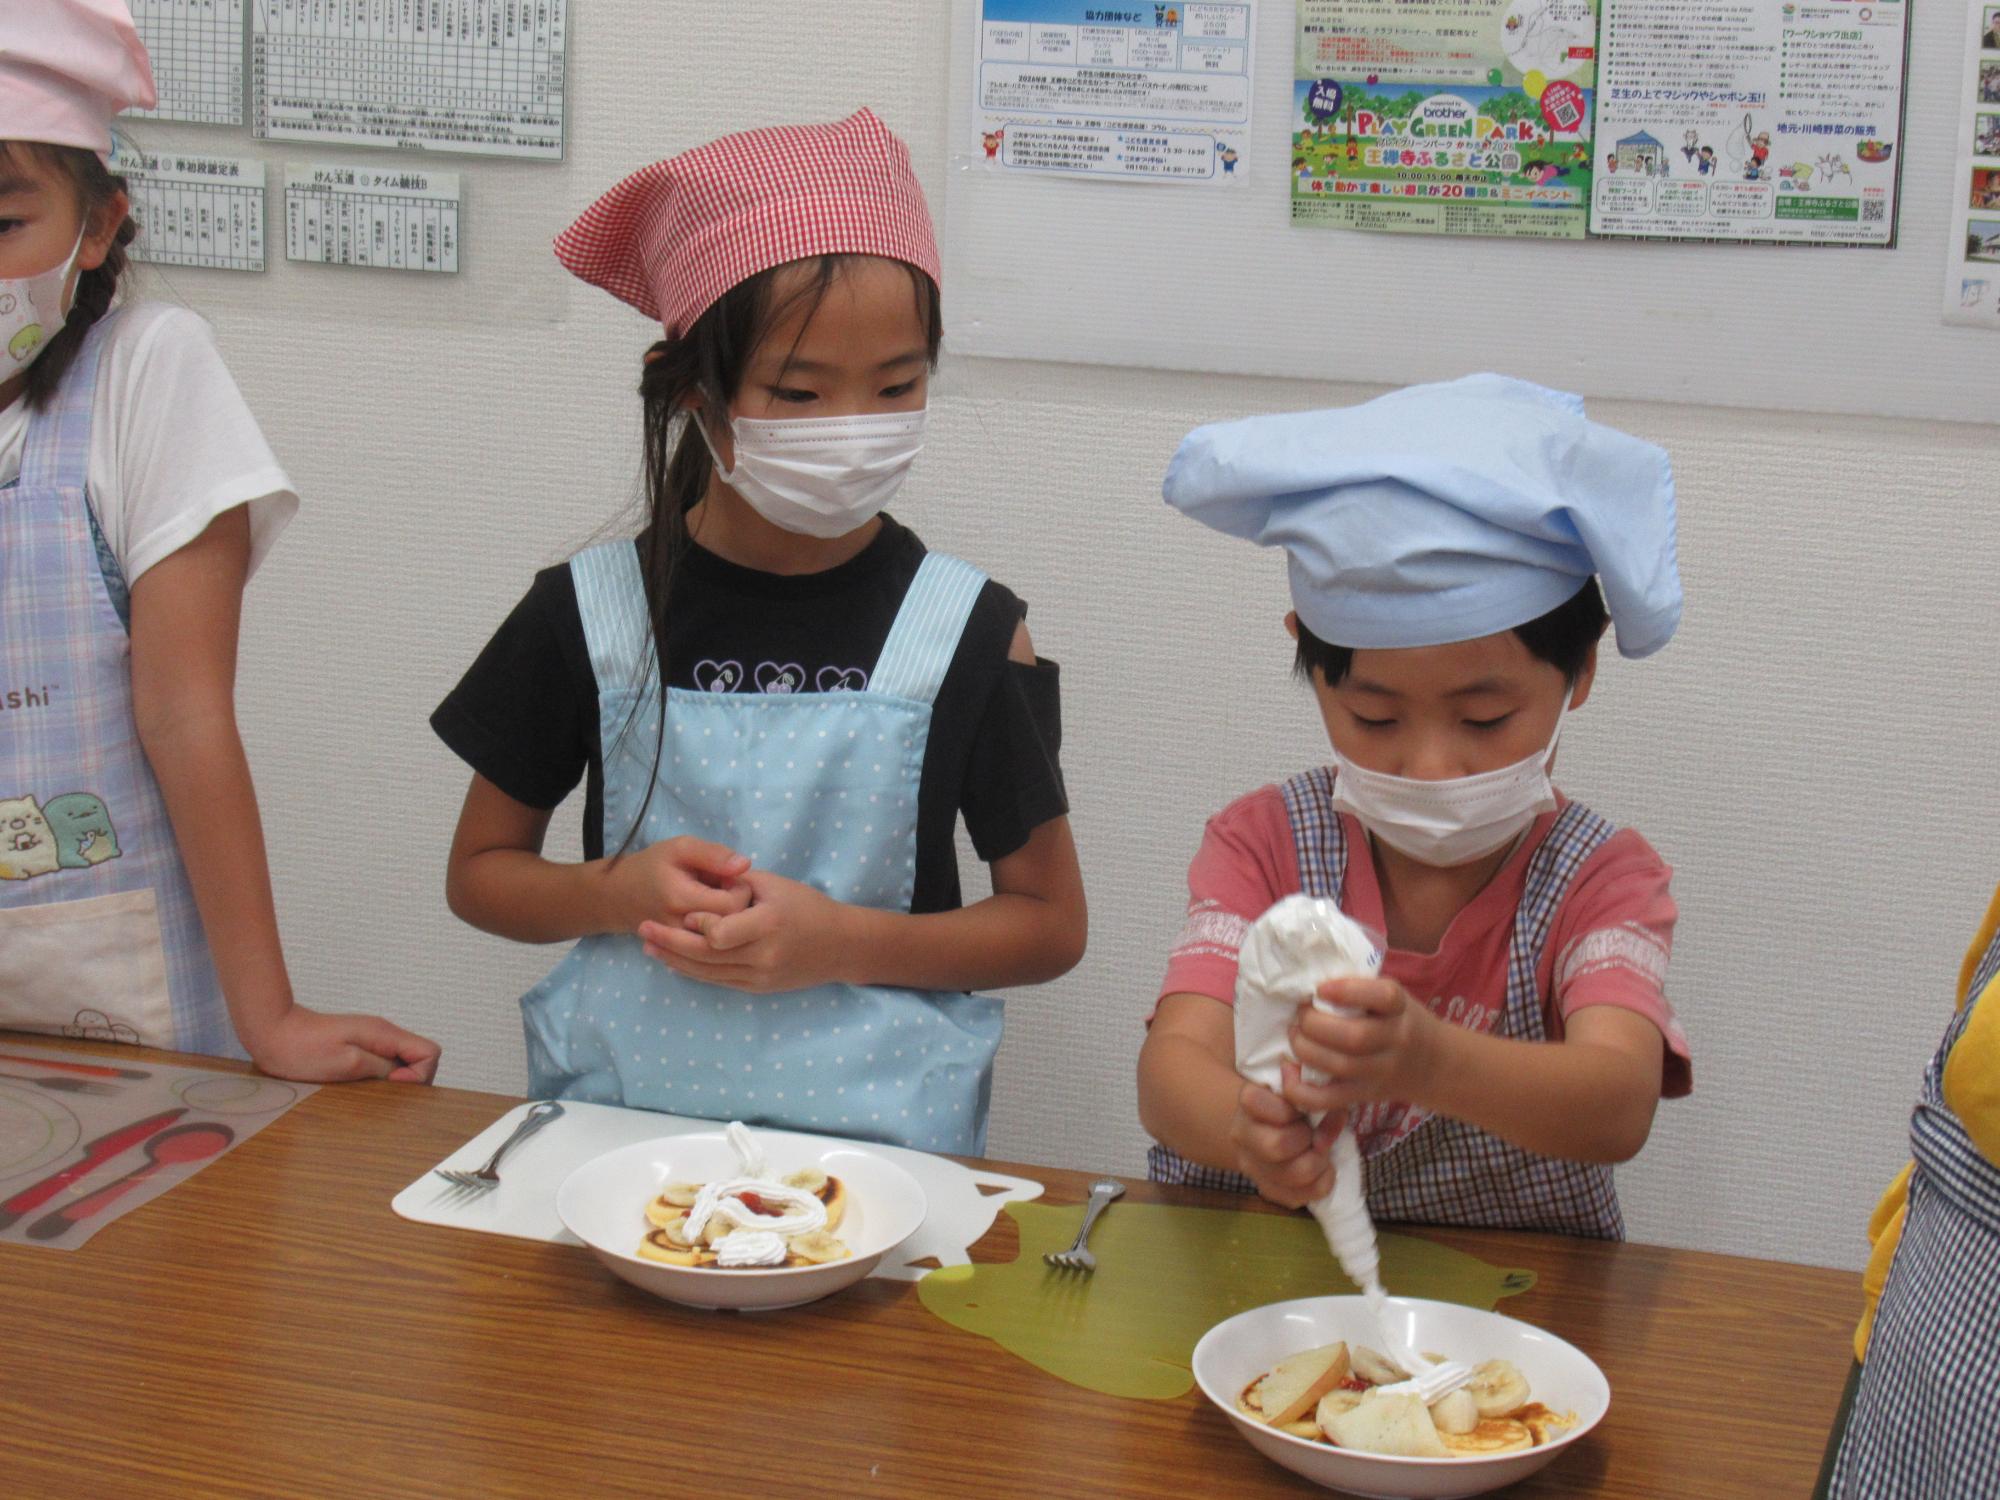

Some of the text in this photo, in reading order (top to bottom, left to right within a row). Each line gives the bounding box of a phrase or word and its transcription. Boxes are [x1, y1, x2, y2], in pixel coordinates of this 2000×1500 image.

[1085, 10, 1142, 22] 協力団体など
[1424, 107, 1467, 119] brother
[1357, 112, 1534, 141] PLAY GREEN PARK
[1366, 149, 1520, 170] 王禅寺ふるさと公園
[176, 159, 239, 178] 準初段認定表
[374, 174, 428, 190] タイム競技B
